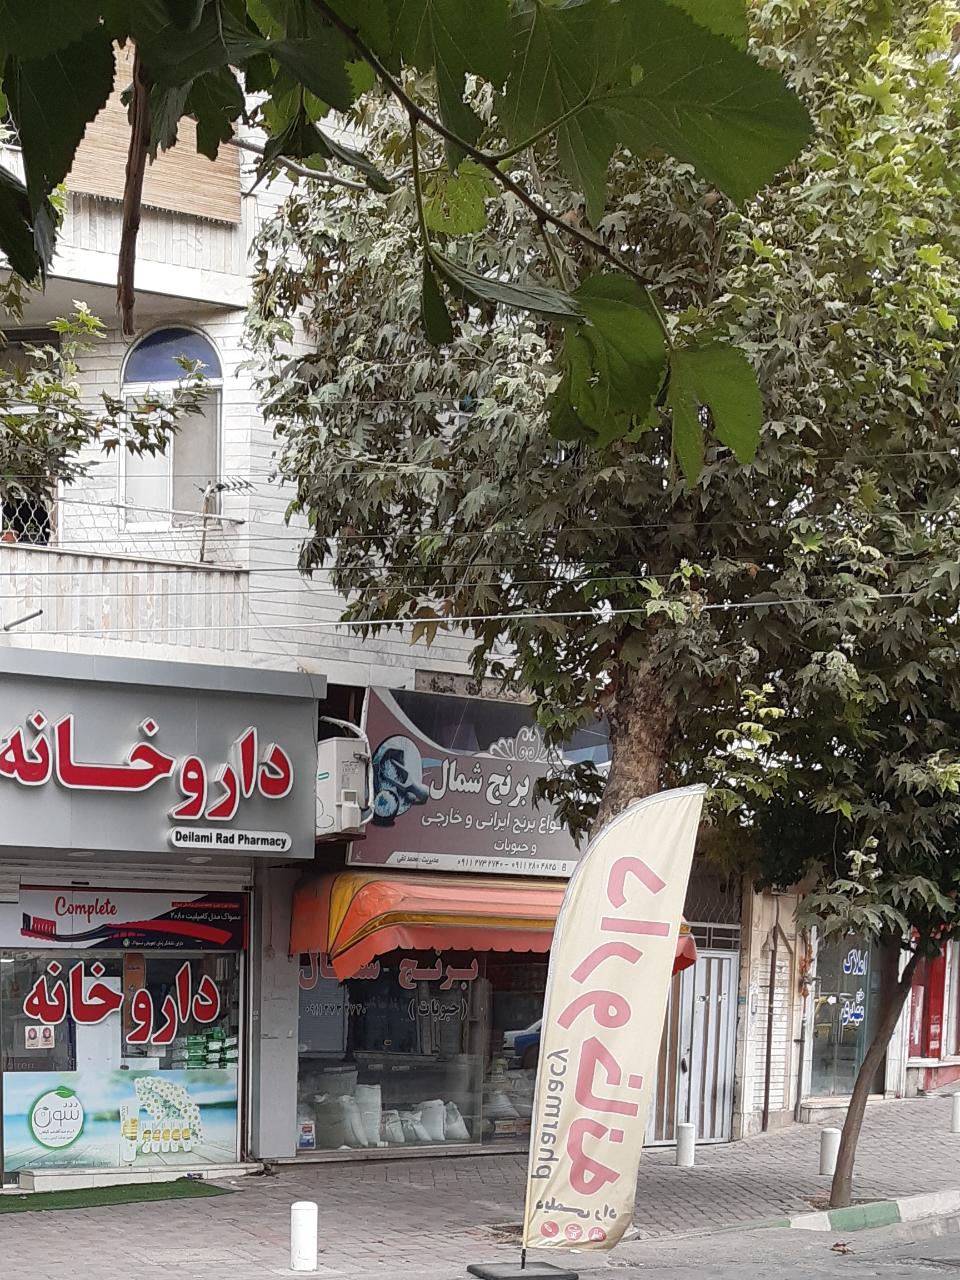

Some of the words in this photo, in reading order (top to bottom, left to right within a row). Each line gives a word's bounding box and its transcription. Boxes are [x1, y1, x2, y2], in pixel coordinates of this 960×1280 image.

[429, 757, 484, 800] شمال
[485, 763, 530, 807] برنج
[421, 807, 463, 827] خارجی
[465, 816, 473, 829] و
[476, 812, 511, 832] ایرانی
[513, 816, 536, 834] برنج
[174, 829, 213, 844] Deilami
[216, 832, 235, 846] Rad
[238, 833, 287, 849] Pharmacy
[493, 837, 529, 854] حبوبات
[530, 842, 537, 855] و
[55, 895, 118, 923] Complete
[299, 946, 380, 990] شال
[399, 949, 479, 990] برنج
[23, 960, 220, 1045] داروخانه
